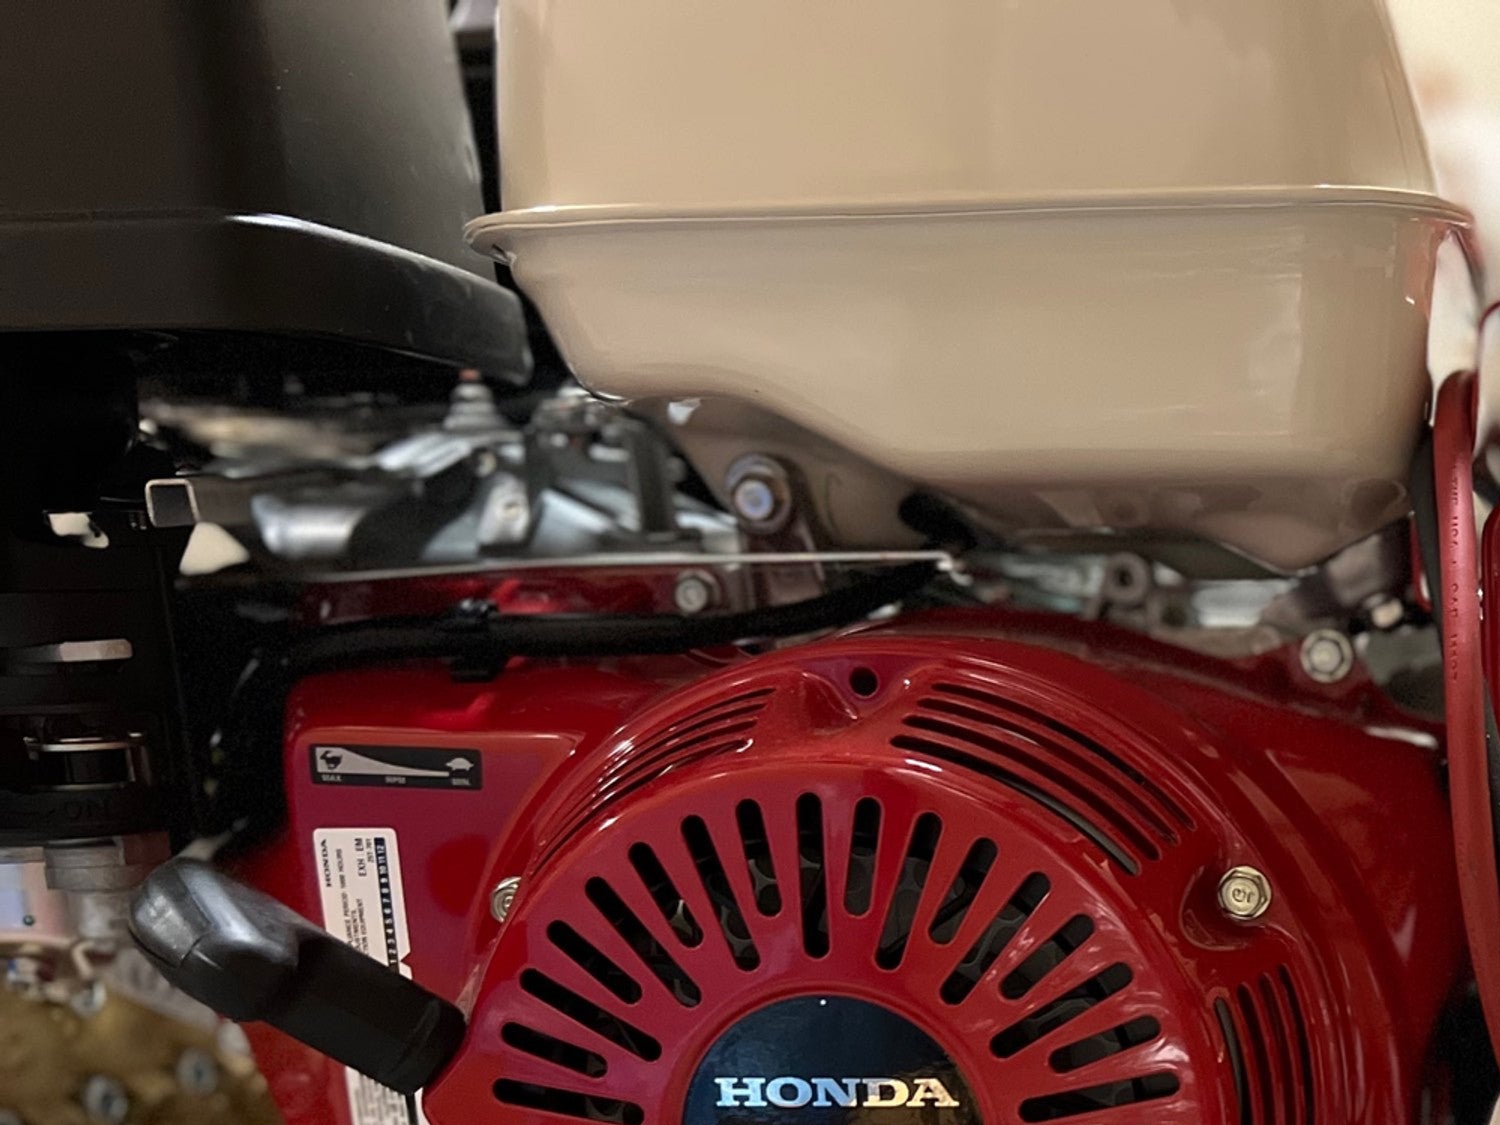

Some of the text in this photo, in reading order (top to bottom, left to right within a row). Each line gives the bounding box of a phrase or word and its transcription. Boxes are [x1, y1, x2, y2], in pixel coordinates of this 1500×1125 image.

[320, 839, 332, 888] HONDA
[354, 838, 367, 877] EXH EM
[714, 1076, 960, 1107] HONDA
